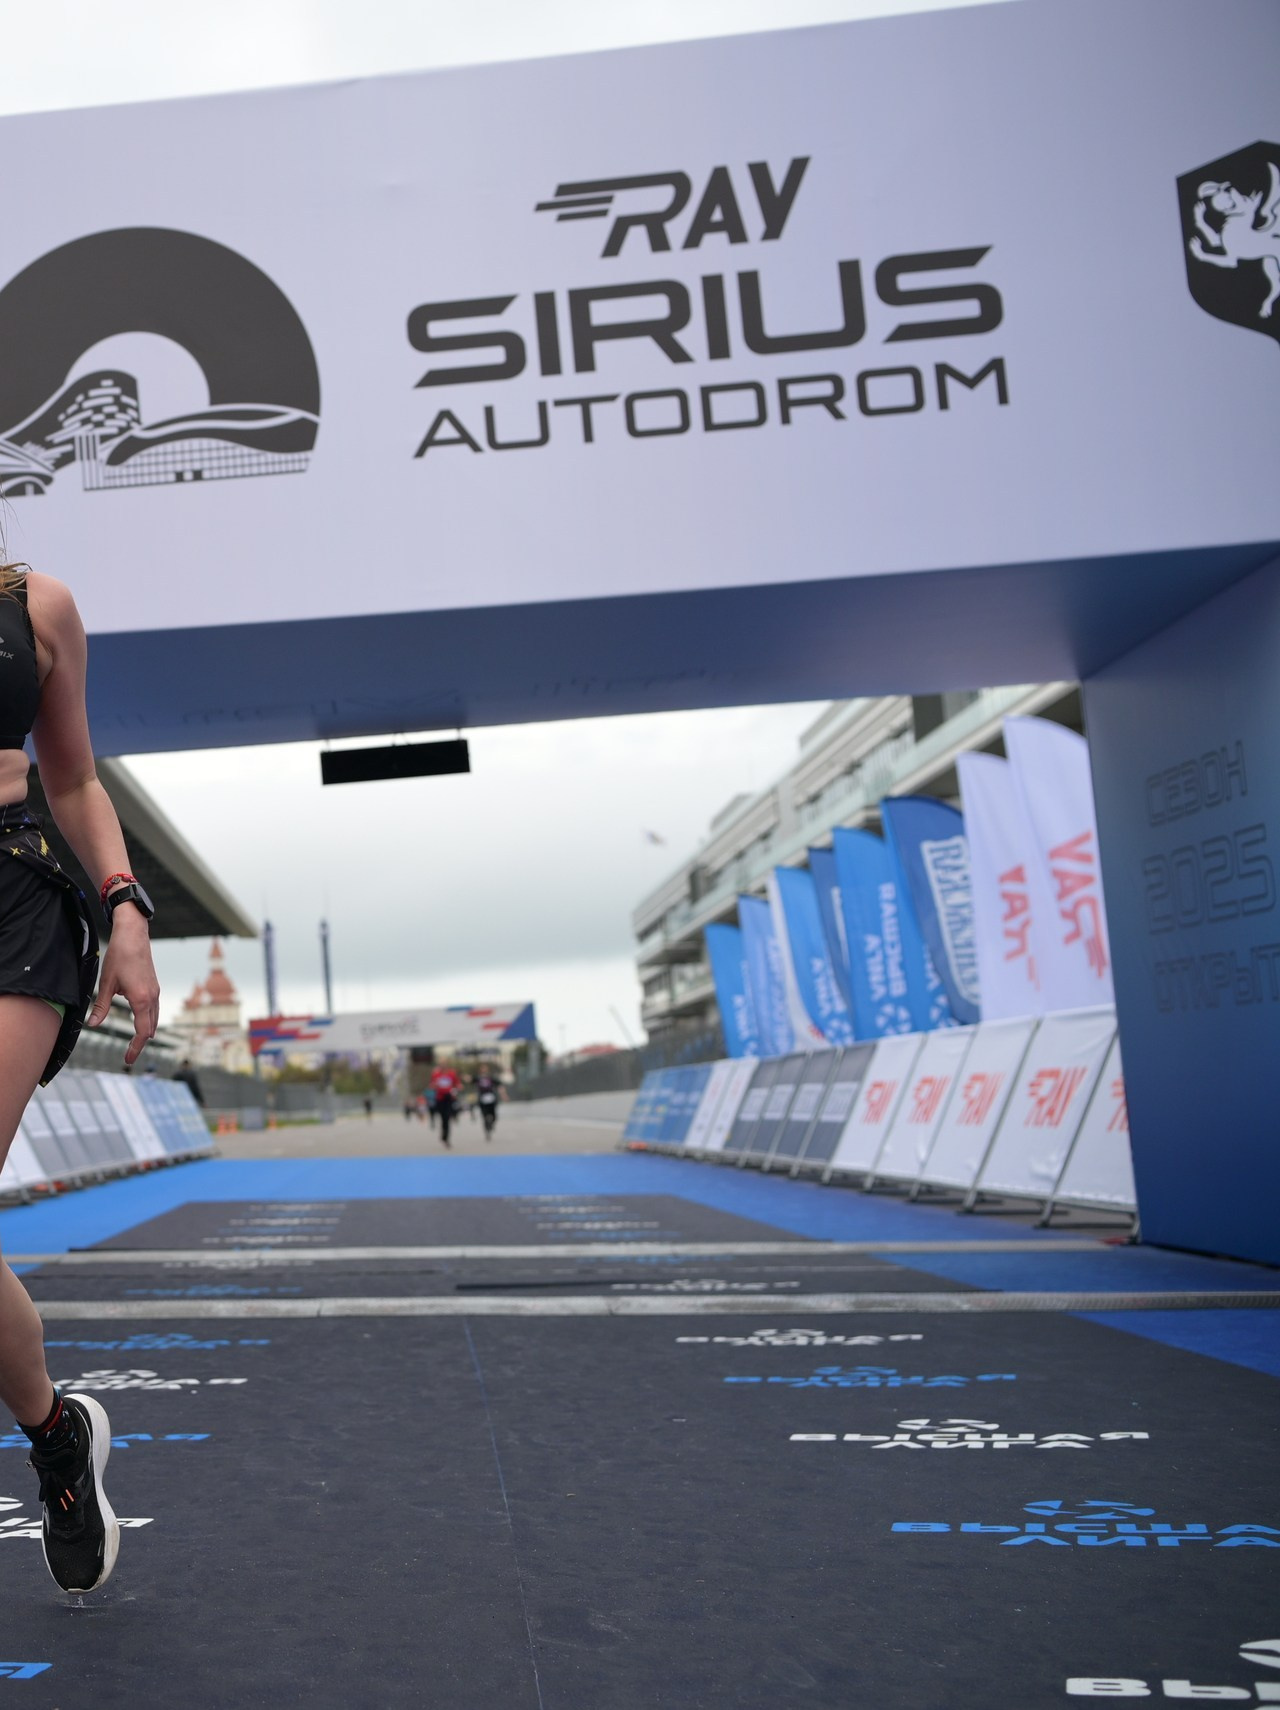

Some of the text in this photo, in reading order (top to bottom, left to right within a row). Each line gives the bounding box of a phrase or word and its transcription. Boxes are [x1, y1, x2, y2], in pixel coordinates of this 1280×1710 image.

[535, 156, 811, 259] RAY
[407, 245, 1004, 389] SIRIUS
[413, 356, 1010, 458] AUTODROM
[1145, 738, 1248, 828] СЕЗОН
[1140, 822, 1278, 936] 2025
[999, 1535, 1280, 1547] ЛИГА
